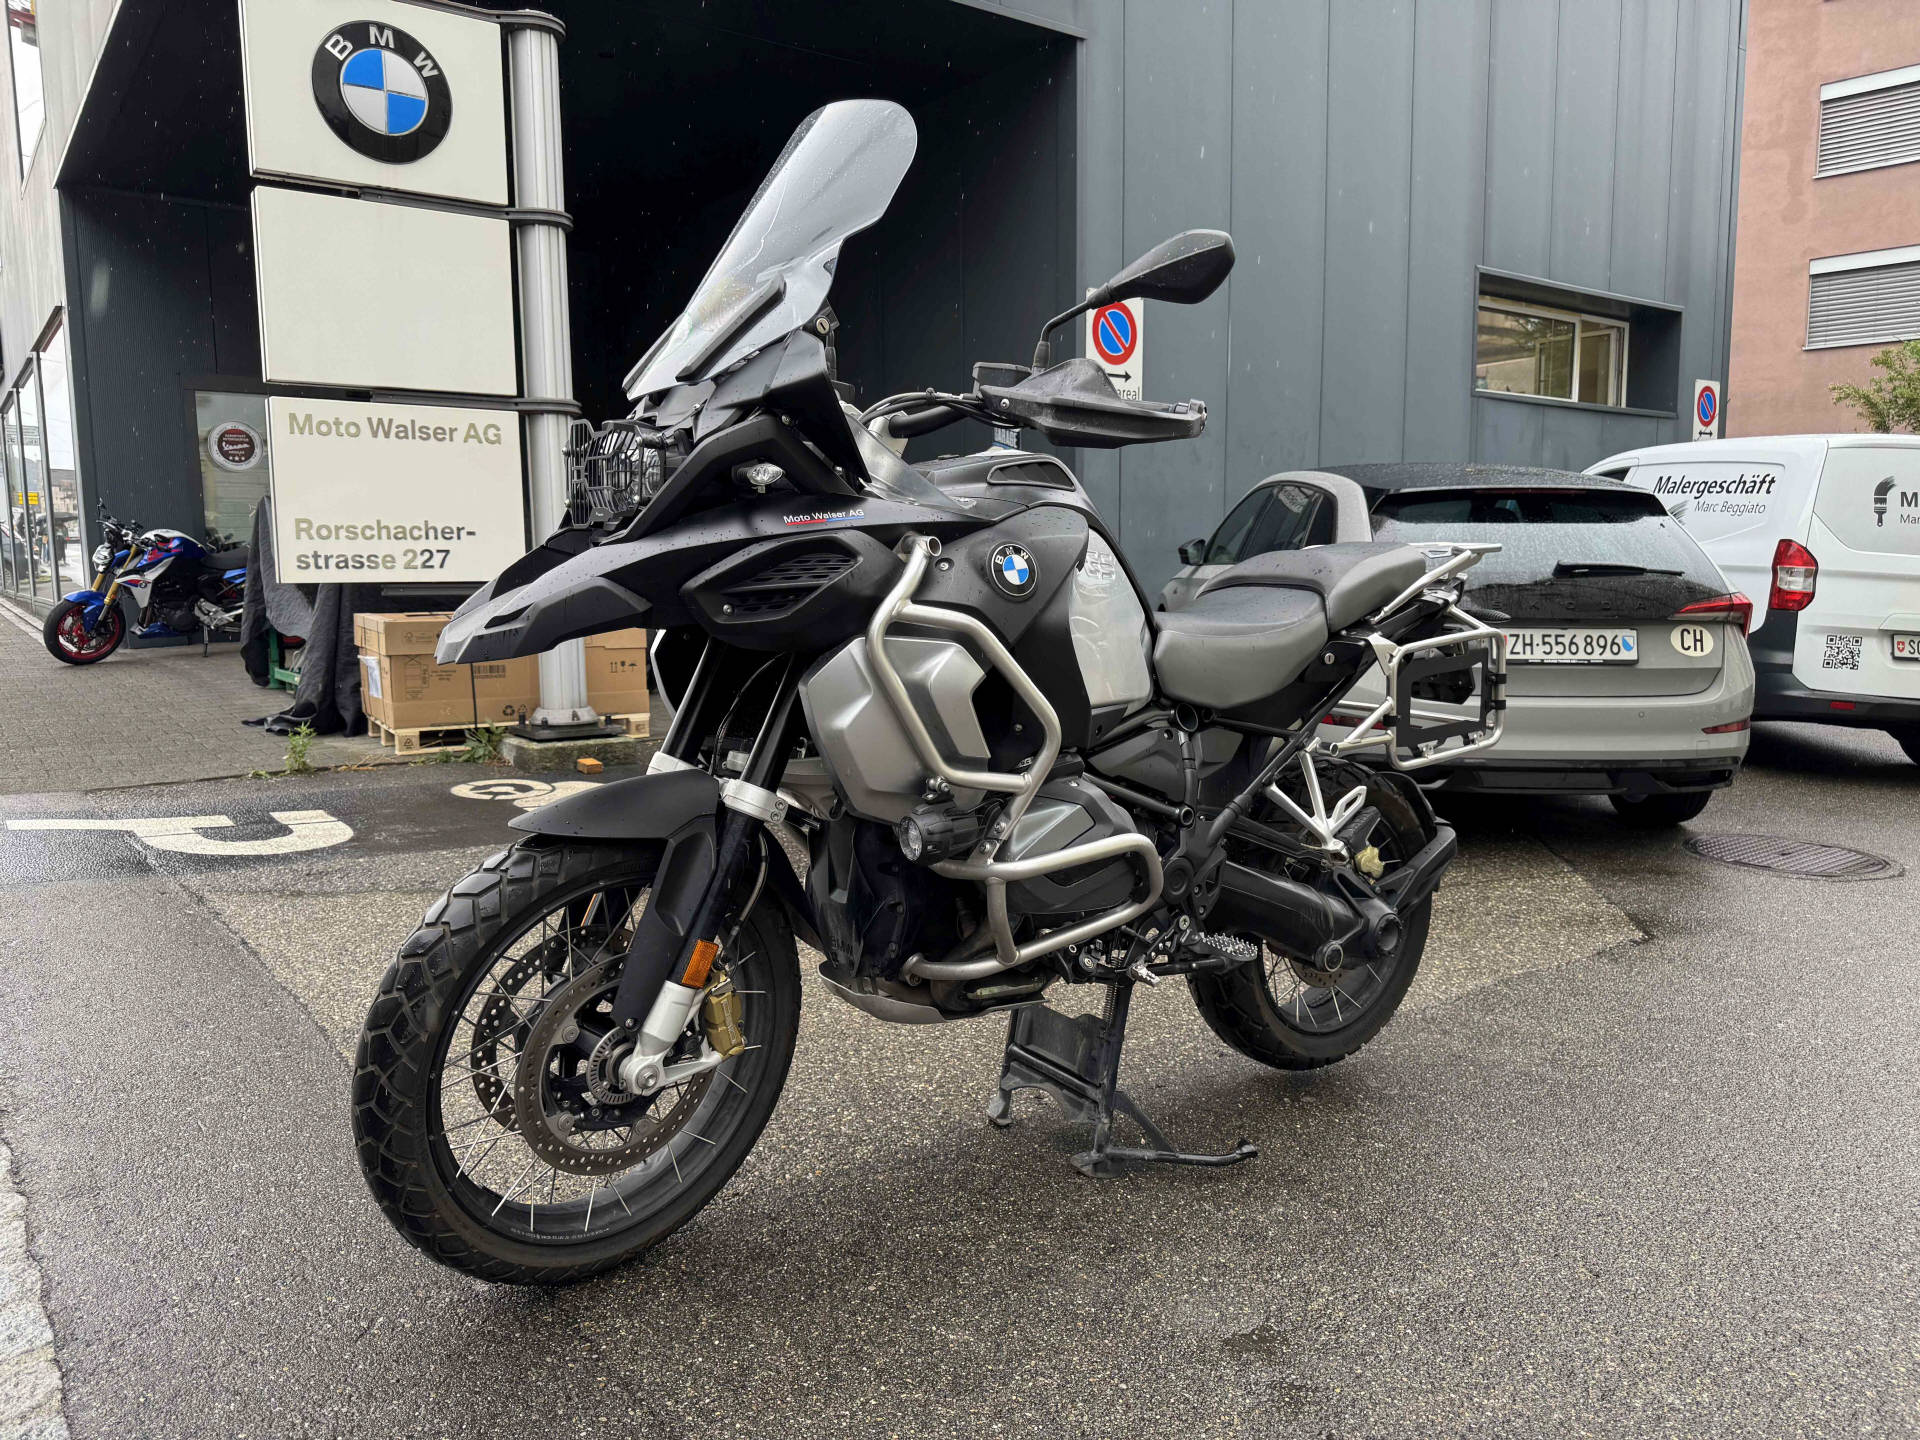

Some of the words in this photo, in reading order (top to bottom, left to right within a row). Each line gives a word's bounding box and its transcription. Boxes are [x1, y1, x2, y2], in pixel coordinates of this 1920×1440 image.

[325, 24, 439, 77] BMW
[288, 413, 361, 437] Moto
[367, 417, 457, 441] Walser
[463, 423, 502, 444] AG
[1653, 474, 1776, 499] Malergeschäft
[783, 515, 811, 524] Moto
[812, 511, 846, 520] Walser
[849, 509, 864, 517] AG
[1694, 501, 1719, 513] Marc
[1720, 501, 1766, 516] Beggiato
[294, 517, 477, 541] Rorschacher-
[296, 550, 397, 570] strasse
[402, 549, 451, 570] 227
[994, 546, 1029, 565] BMW
[1680, 628, 1704, 652] CH
